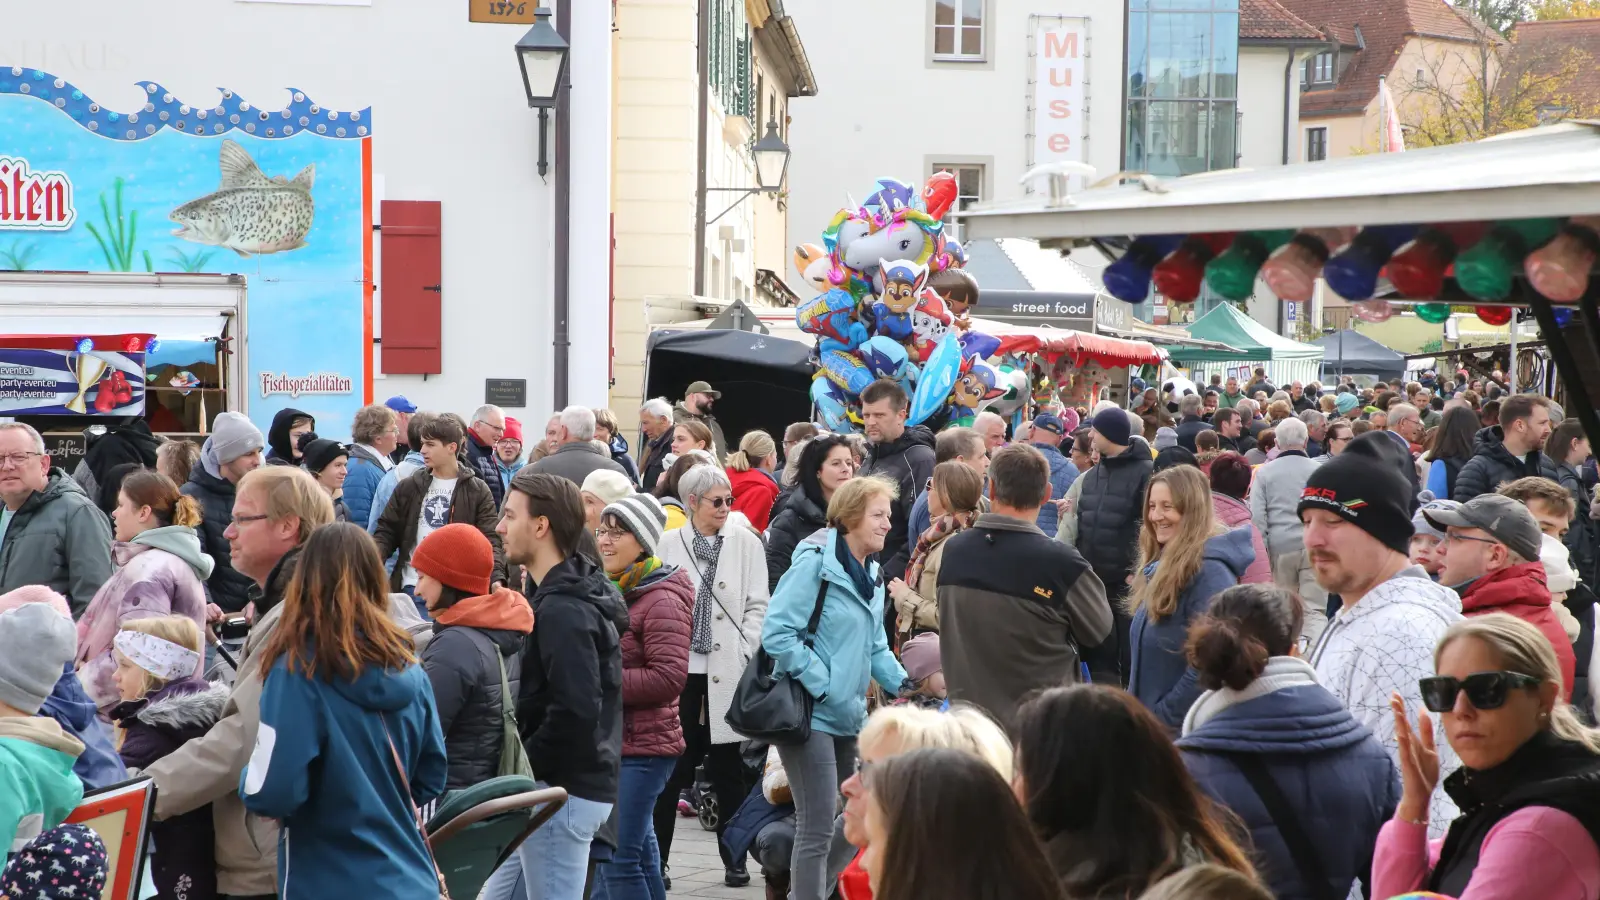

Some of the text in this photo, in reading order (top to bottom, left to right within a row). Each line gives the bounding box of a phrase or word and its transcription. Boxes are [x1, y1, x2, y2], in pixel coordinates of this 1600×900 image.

[1044, 32, 1078, 153] Muse
[1012, 302, 1086, 314] street food
[0, 379, 57, 388] party-event.eu
[262, 373, 351, 394] Fischspezialitäten
[0, 390, 56, 399] party-event.eu
